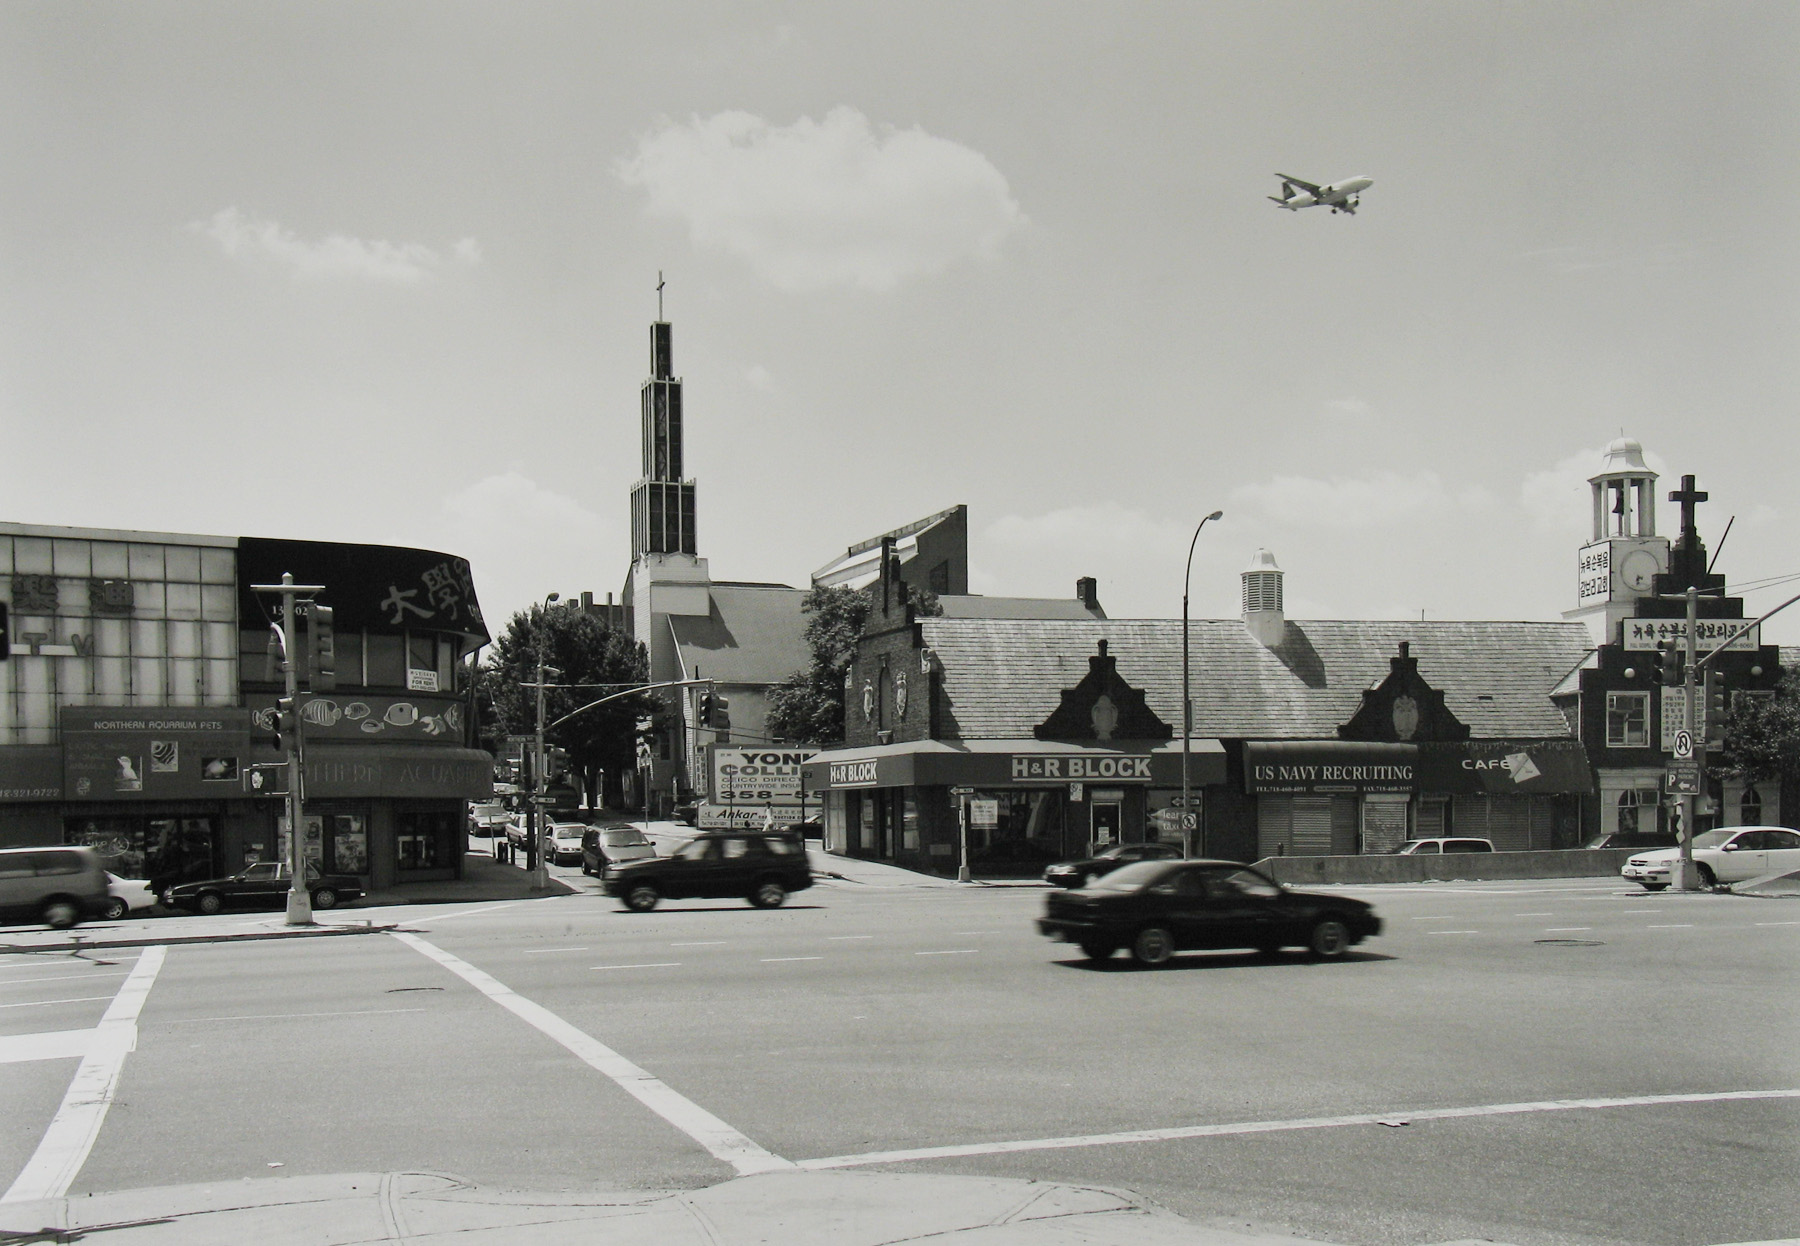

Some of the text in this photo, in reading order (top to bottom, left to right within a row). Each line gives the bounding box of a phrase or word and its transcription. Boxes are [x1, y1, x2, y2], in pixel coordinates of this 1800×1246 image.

[94, 720, 223, 730] NORTHERN AQUARIUM PETS
[720, 764, 798, 776] COLLI
[1012, 757, 1152, 778] H&R BLOCK
[1461, 759, 1511, 770] CAFE
[830, 762, 877, 783] H&R BLOCK
[1254, 765, 1413, 780] US NAVY RECRUITING
[1668, 774, 1676, 786] P
[716, 809, 758, 819] Ankar
